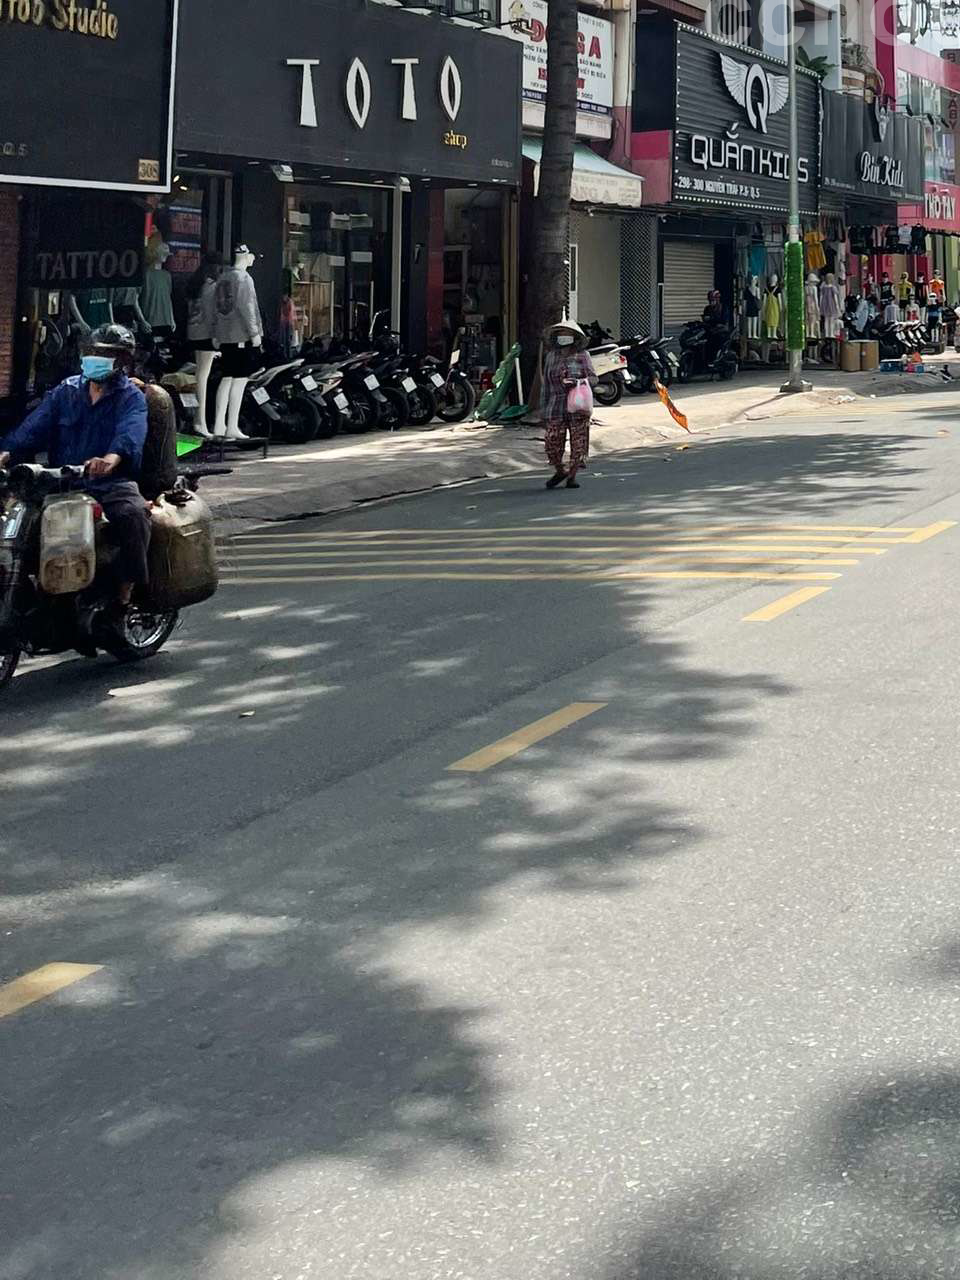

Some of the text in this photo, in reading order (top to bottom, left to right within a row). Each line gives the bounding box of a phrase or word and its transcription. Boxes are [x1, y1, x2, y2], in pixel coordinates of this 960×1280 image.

[286, 56, 462, 129] TOTO
[860, 151, 904, 188] Bin Kids
[37, 249, 139, 280] TATTOO
